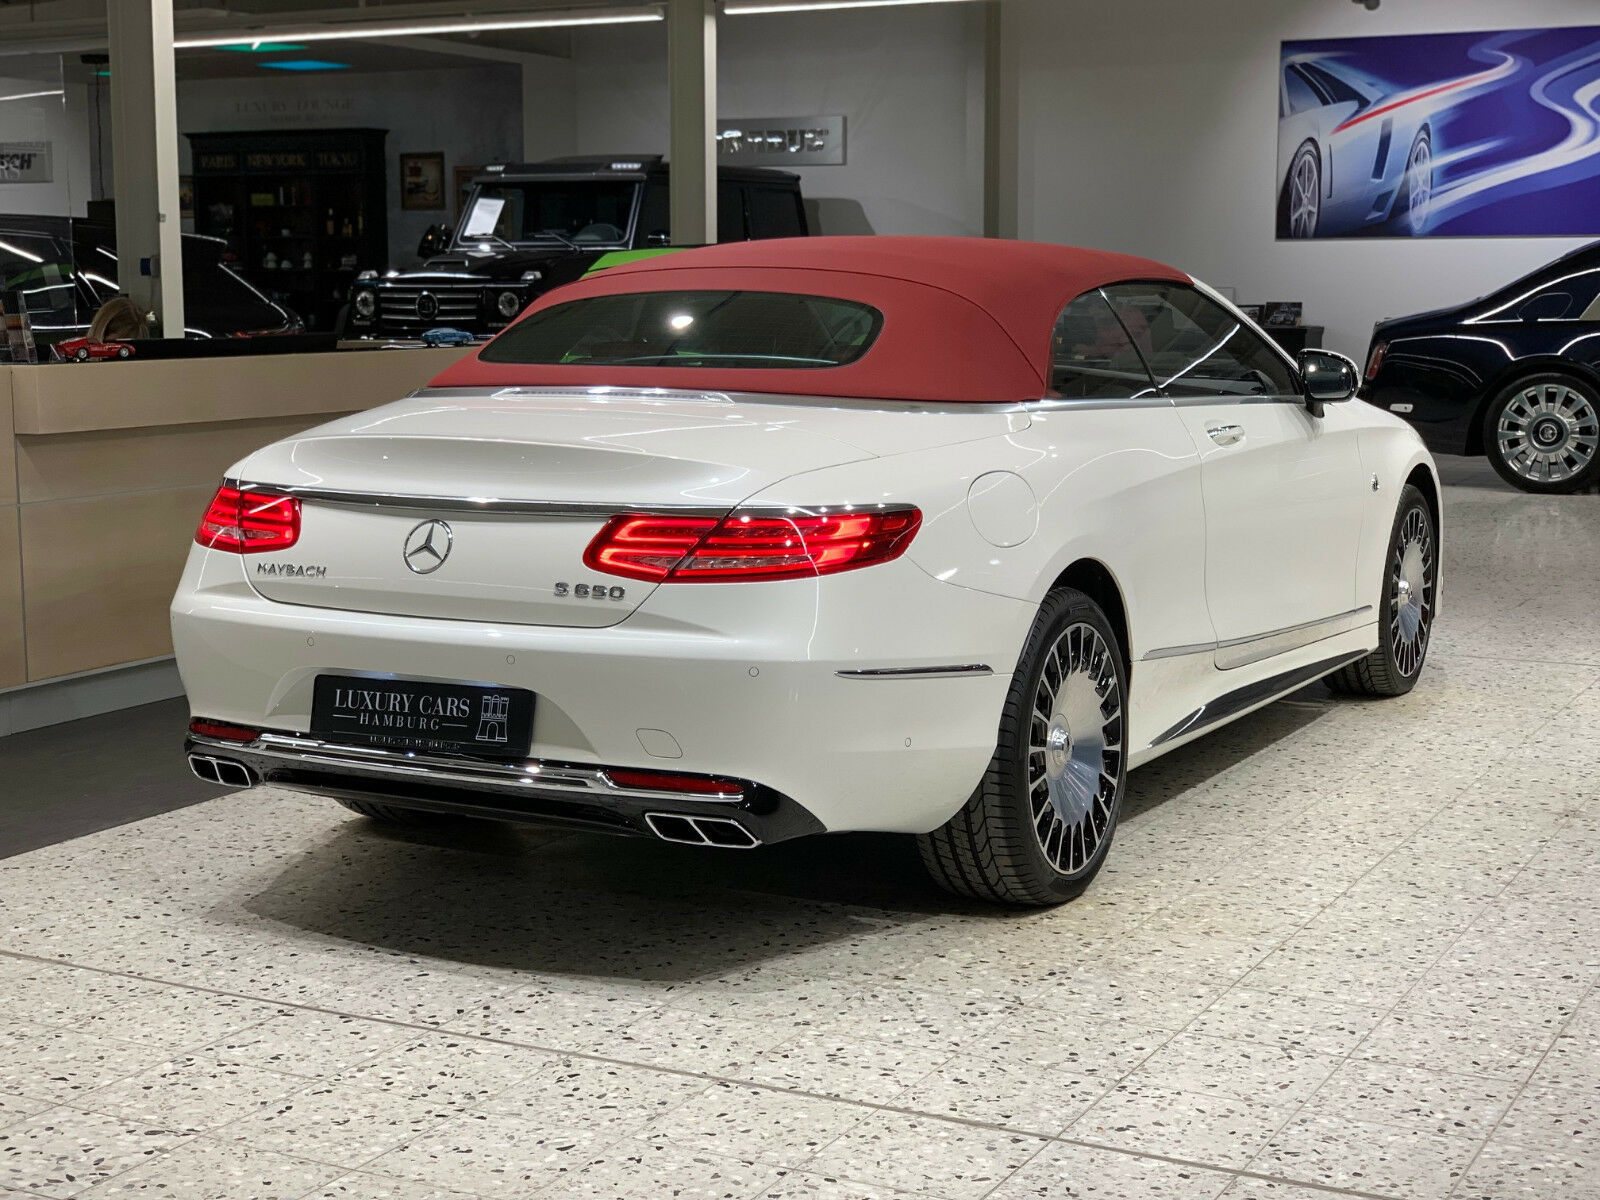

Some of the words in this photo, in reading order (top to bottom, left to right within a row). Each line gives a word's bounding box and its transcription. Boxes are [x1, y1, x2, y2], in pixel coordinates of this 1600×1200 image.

[257, 563, 327, 578] MAYBACH
[554, 582, 569, 597] S
[575, 583, 625, 601] 650
[335, 688, 415, 713] LUXURY
[419, 695, 470, 718] CARS
[359, 713, 440, 731] HAMBURG
